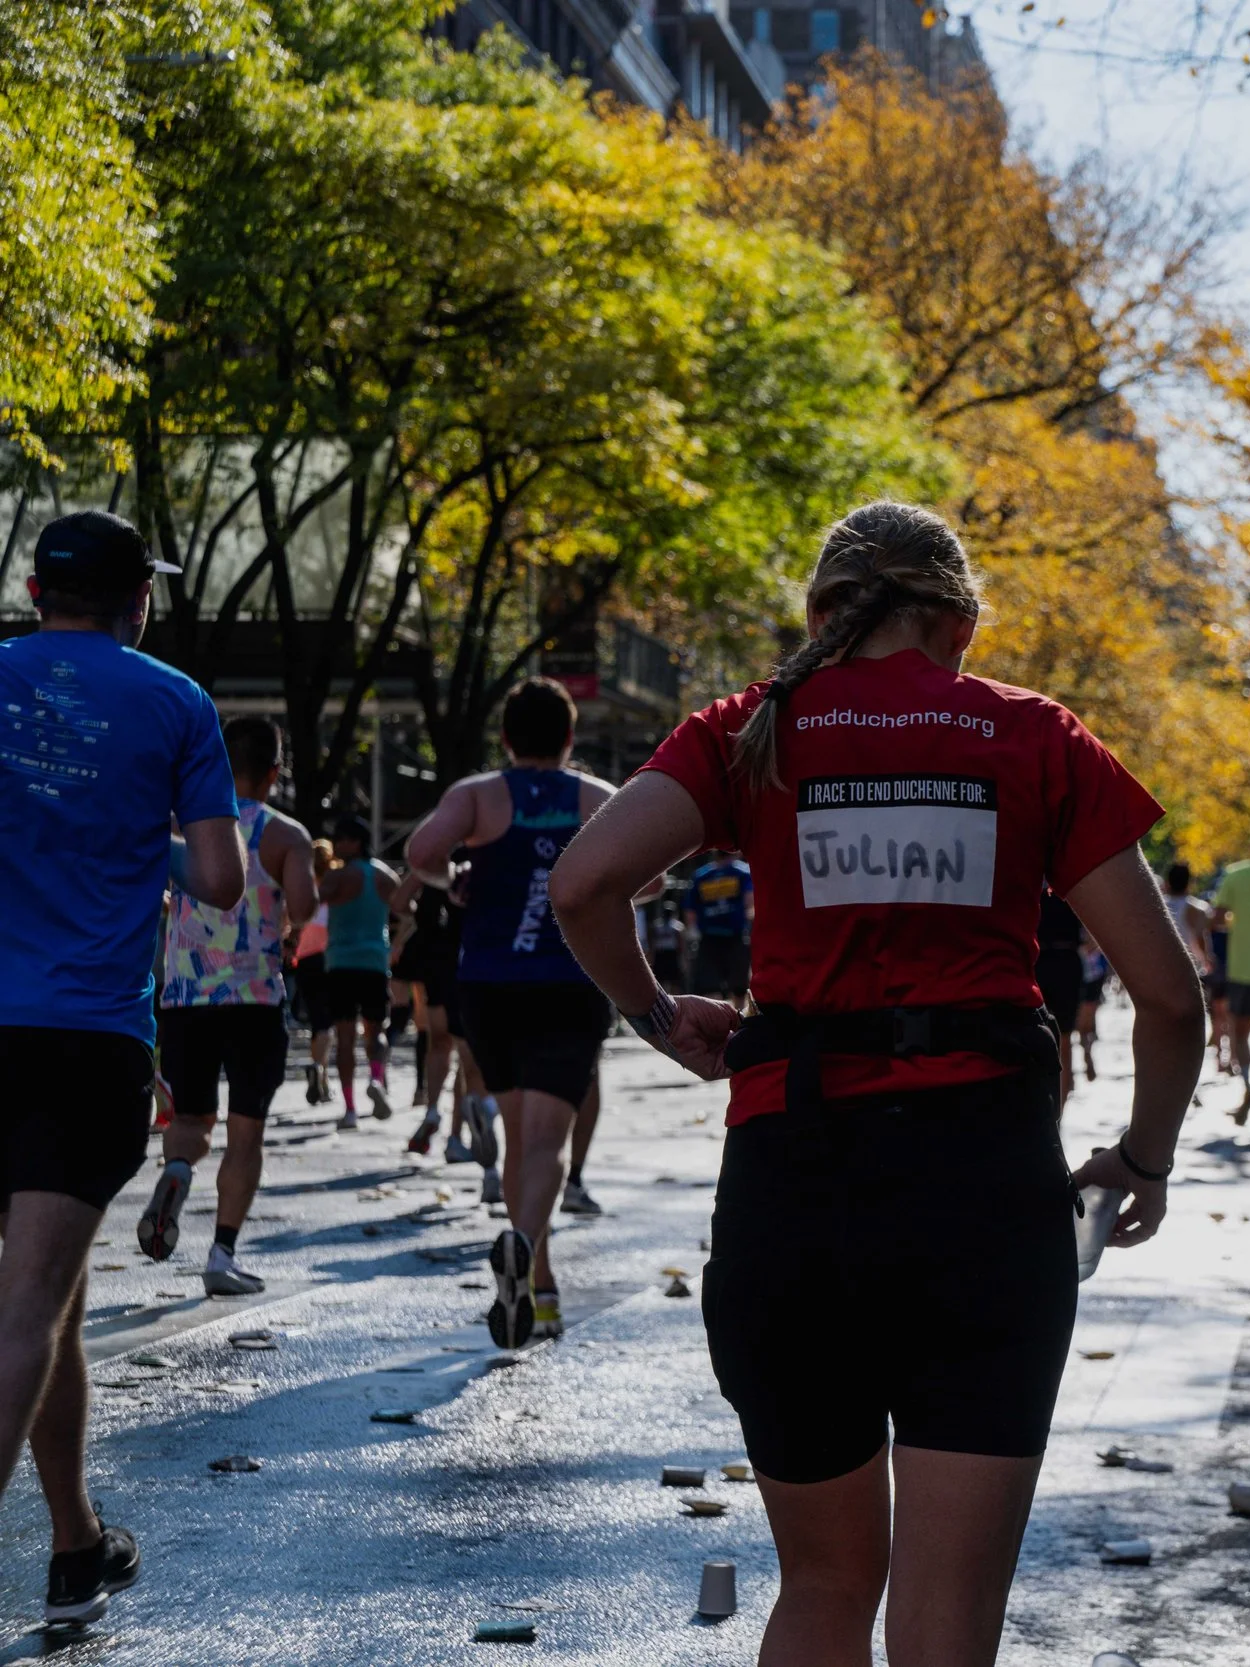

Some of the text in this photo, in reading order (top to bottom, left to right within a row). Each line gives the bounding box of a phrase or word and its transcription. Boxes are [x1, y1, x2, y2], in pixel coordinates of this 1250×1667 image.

[797, 708, 994, 737] endduchenne.org
[808, 779, 987, 805] I RACE TO END DUCHENNE FOR:
